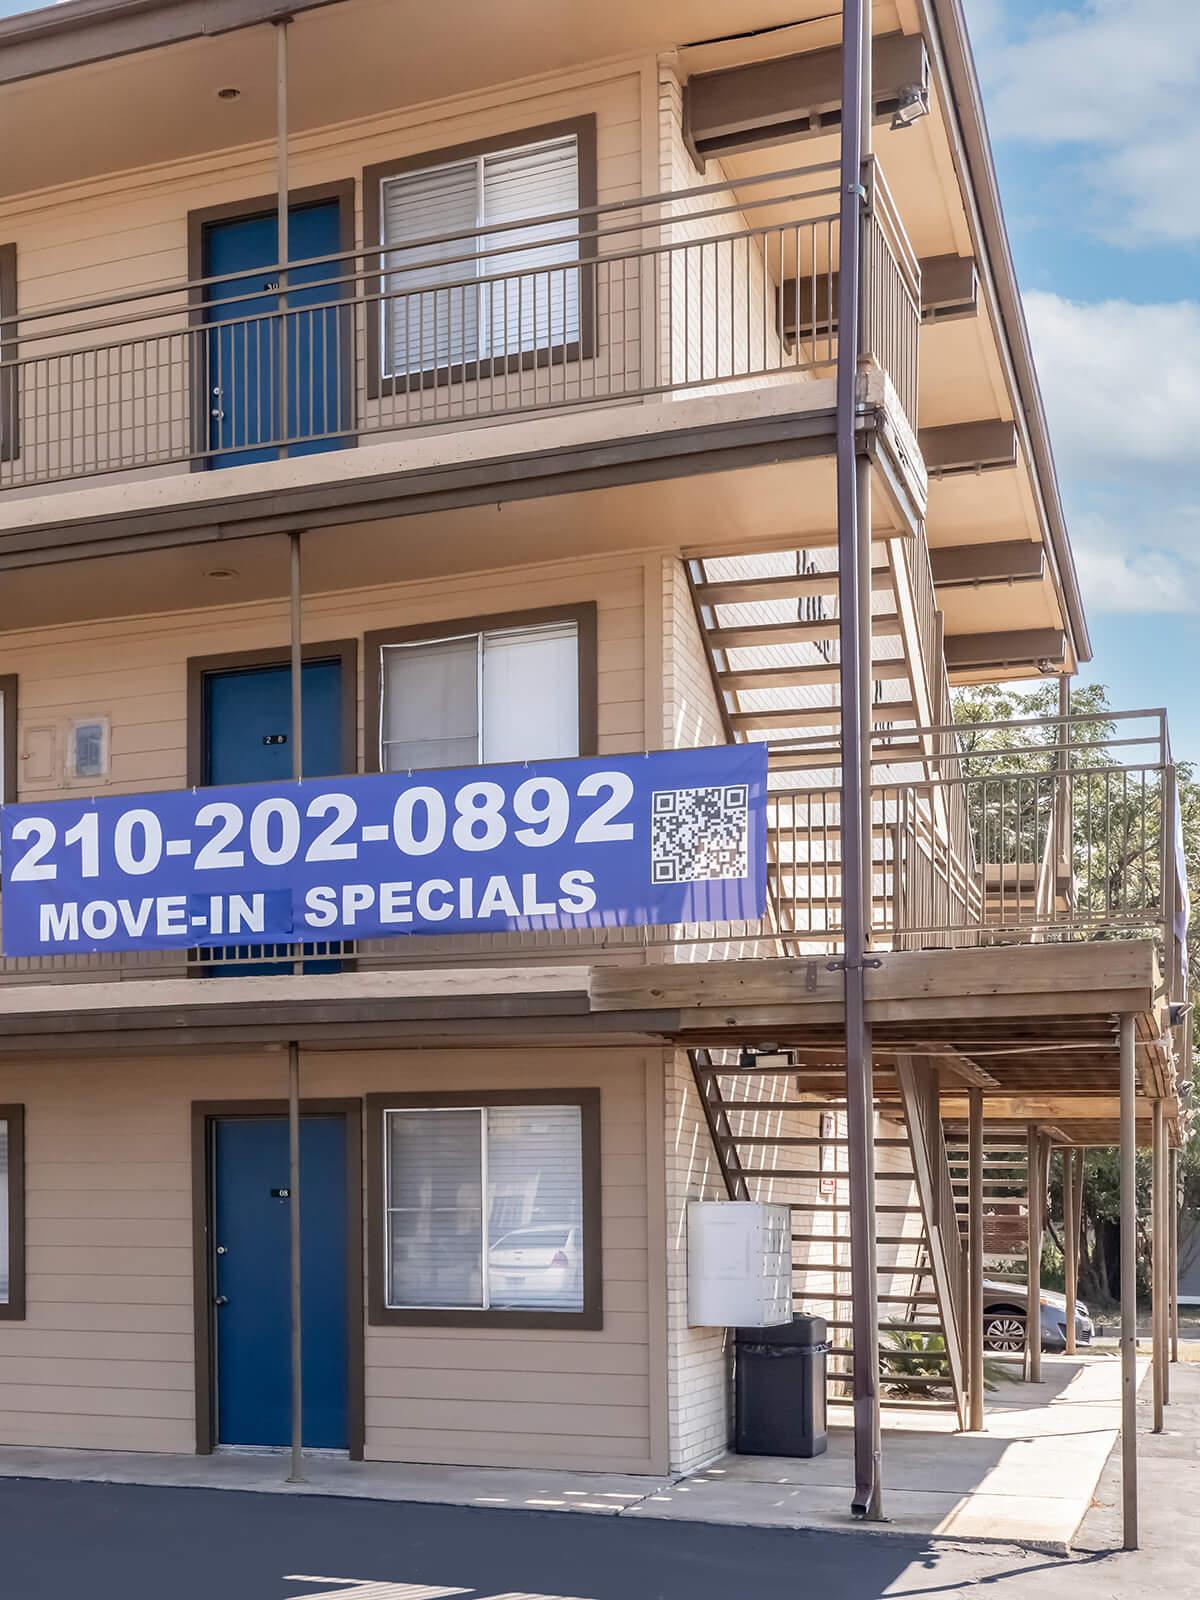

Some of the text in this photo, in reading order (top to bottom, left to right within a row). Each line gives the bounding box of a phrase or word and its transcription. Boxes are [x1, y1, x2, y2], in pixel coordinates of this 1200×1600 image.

[10, 771, 634, 882] 210-202-0892
[39, 869, 597, 942] MOVE-IN SPECIALS
